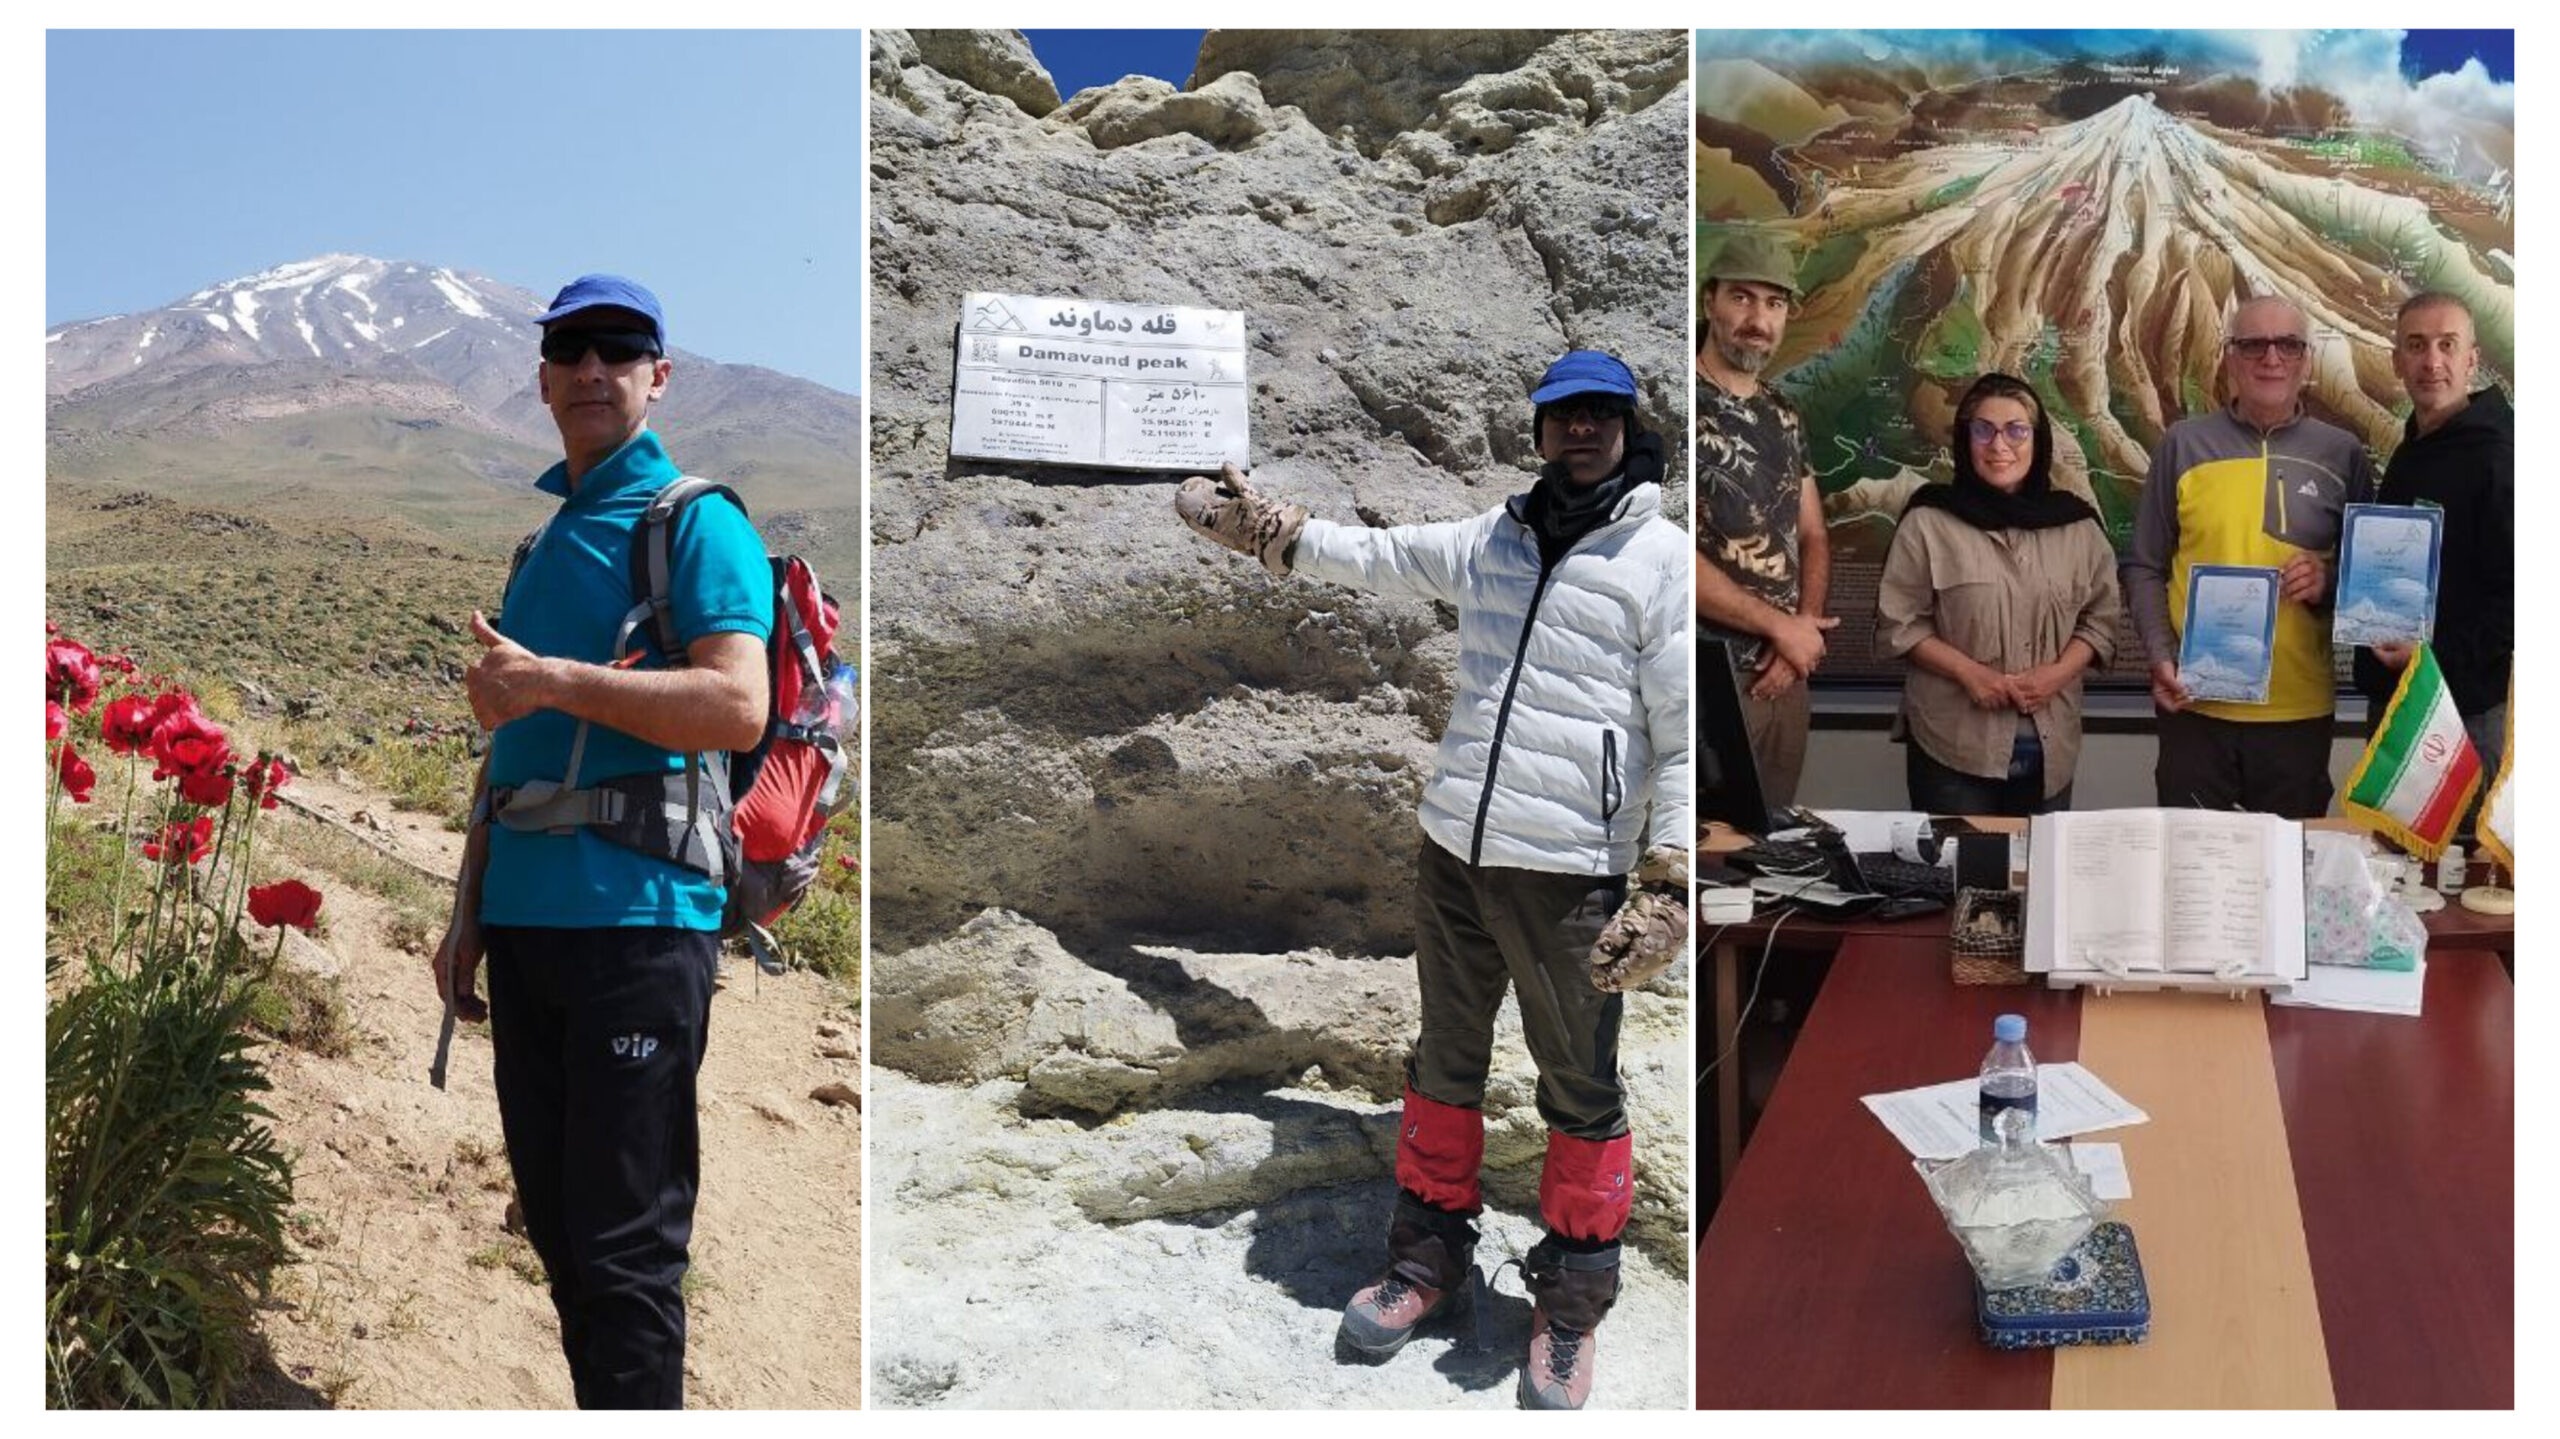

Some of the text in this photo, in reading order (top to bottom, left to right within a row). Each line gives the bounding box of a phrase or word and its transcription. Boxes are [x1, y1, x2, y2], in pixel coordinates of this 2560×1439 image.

[1049, 307, 1133, 336] دماوند
[1141, 312, 1177, 335] قله
[1018, 345, 1189, 370] Damavand peak
[1145, 388, 1165, 402] متر
